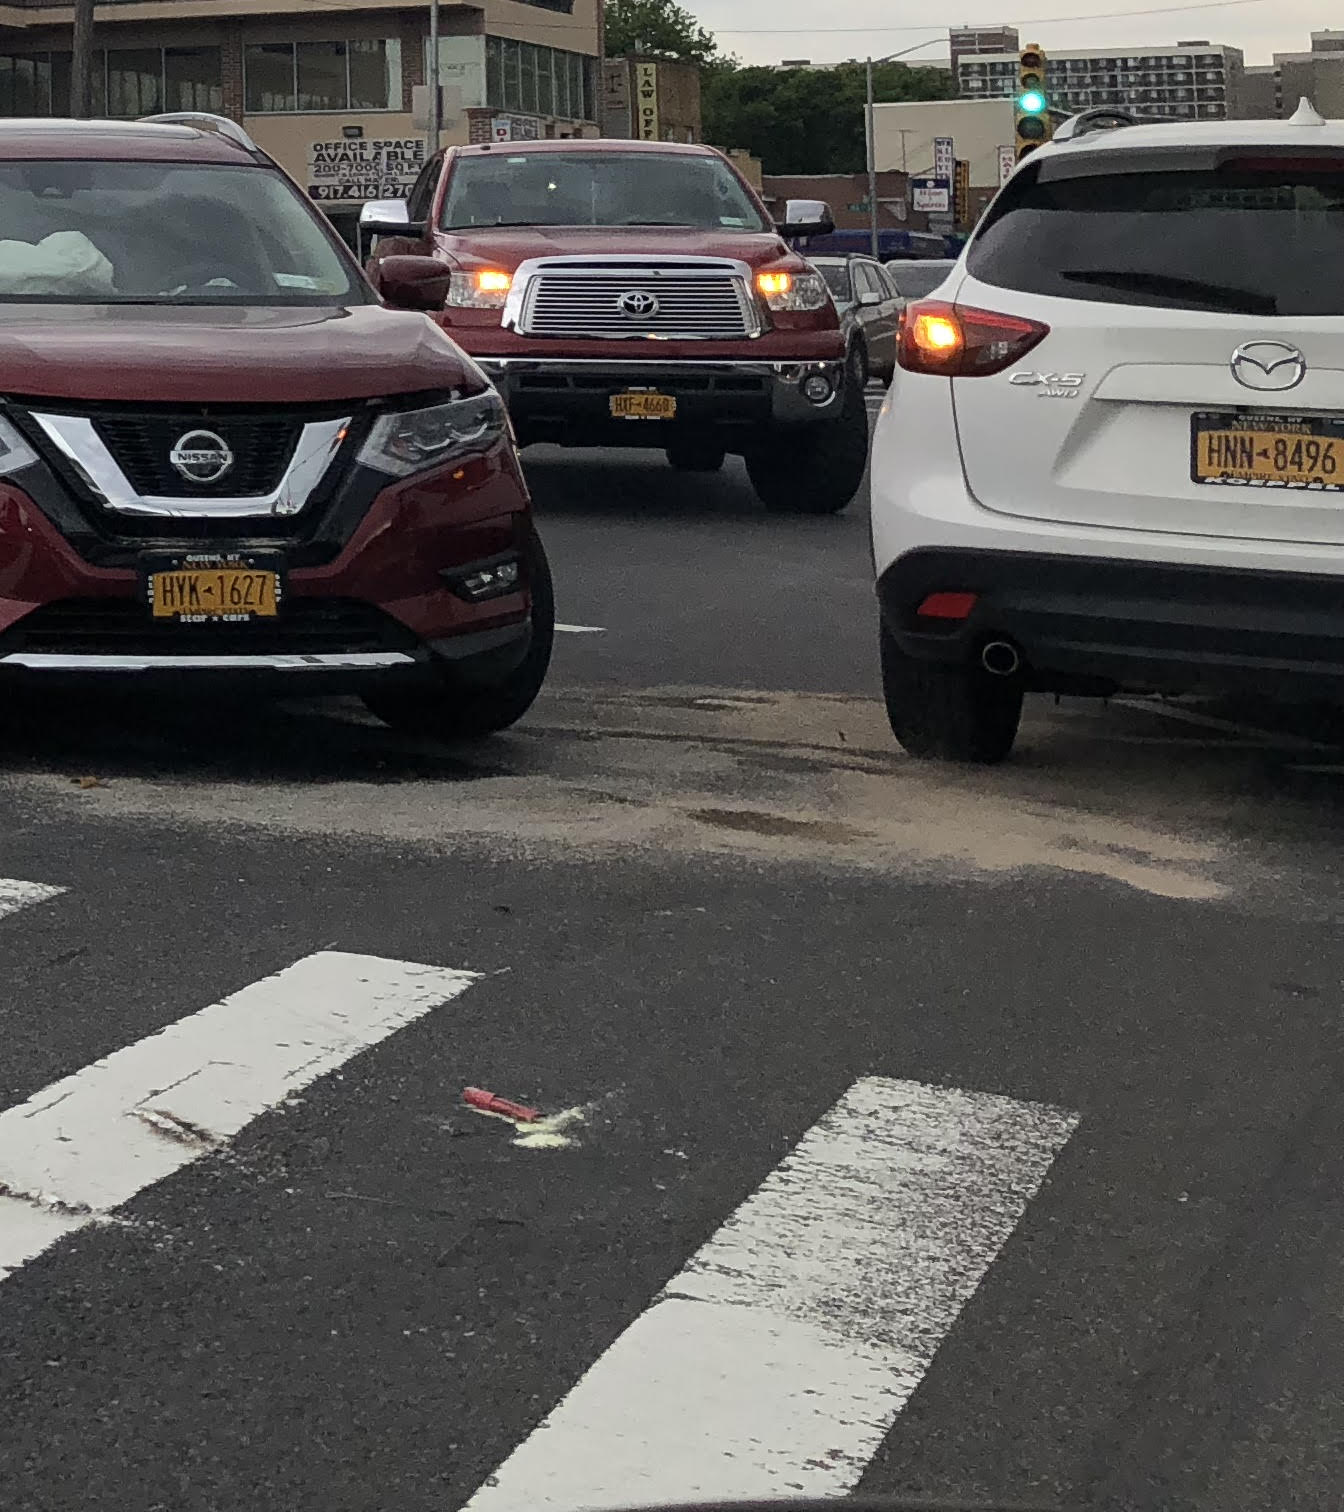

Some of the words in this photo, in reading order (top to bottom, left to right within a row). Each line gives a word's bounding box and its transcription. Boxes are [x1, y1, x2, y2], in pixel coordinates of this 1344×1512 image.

[640, 67, 654, 99] LAW
[313, 141, 368, 153] OFFICE
[372, 139, 424, 151] SPACE
[313, 150, 424, 163] AVAILABLE
[1008, 372, 1086, 387] CX-5
[1273, 423, 1313, 435] YORK
[177, 452, 228, 462] NISSAN
